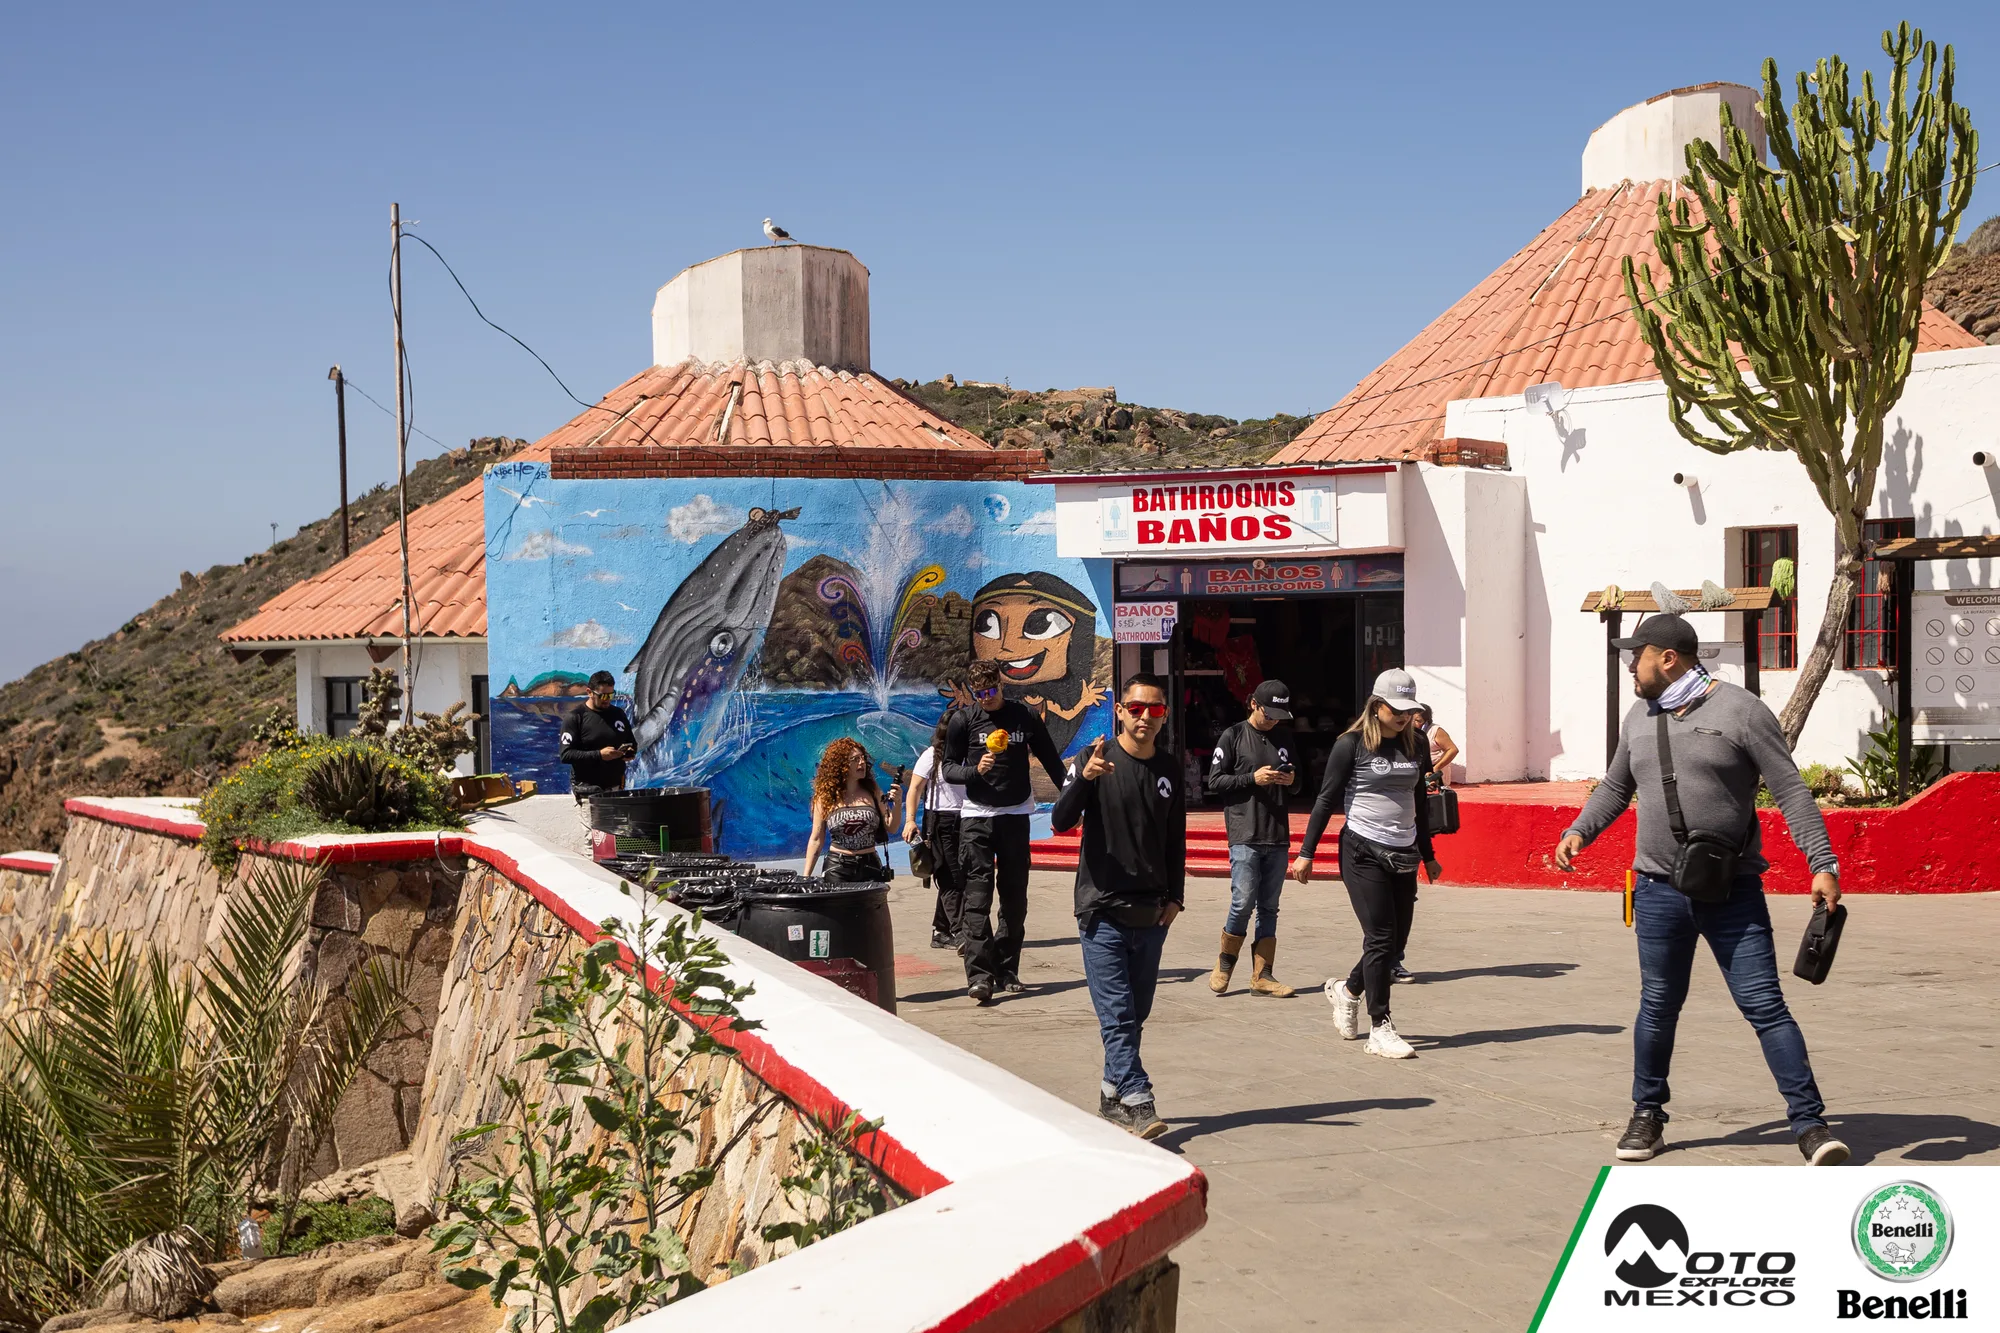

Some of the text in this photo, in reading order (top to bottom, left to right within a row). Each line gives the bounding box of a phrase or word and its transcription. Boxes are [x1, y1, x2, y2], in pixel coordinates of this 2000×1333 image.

[1132, 480, 1295, 513] BATHROOMS
[1137, 512, 1292, 544] BAÑOS
[1208, 565, 1322, 583] BAÑOS
[1206, 580, 1324, 594] BATHROOMS
[1117, 603, 1175, 617] BAÑOS
[1117, 631, 1161, 642] BATHROOMS
